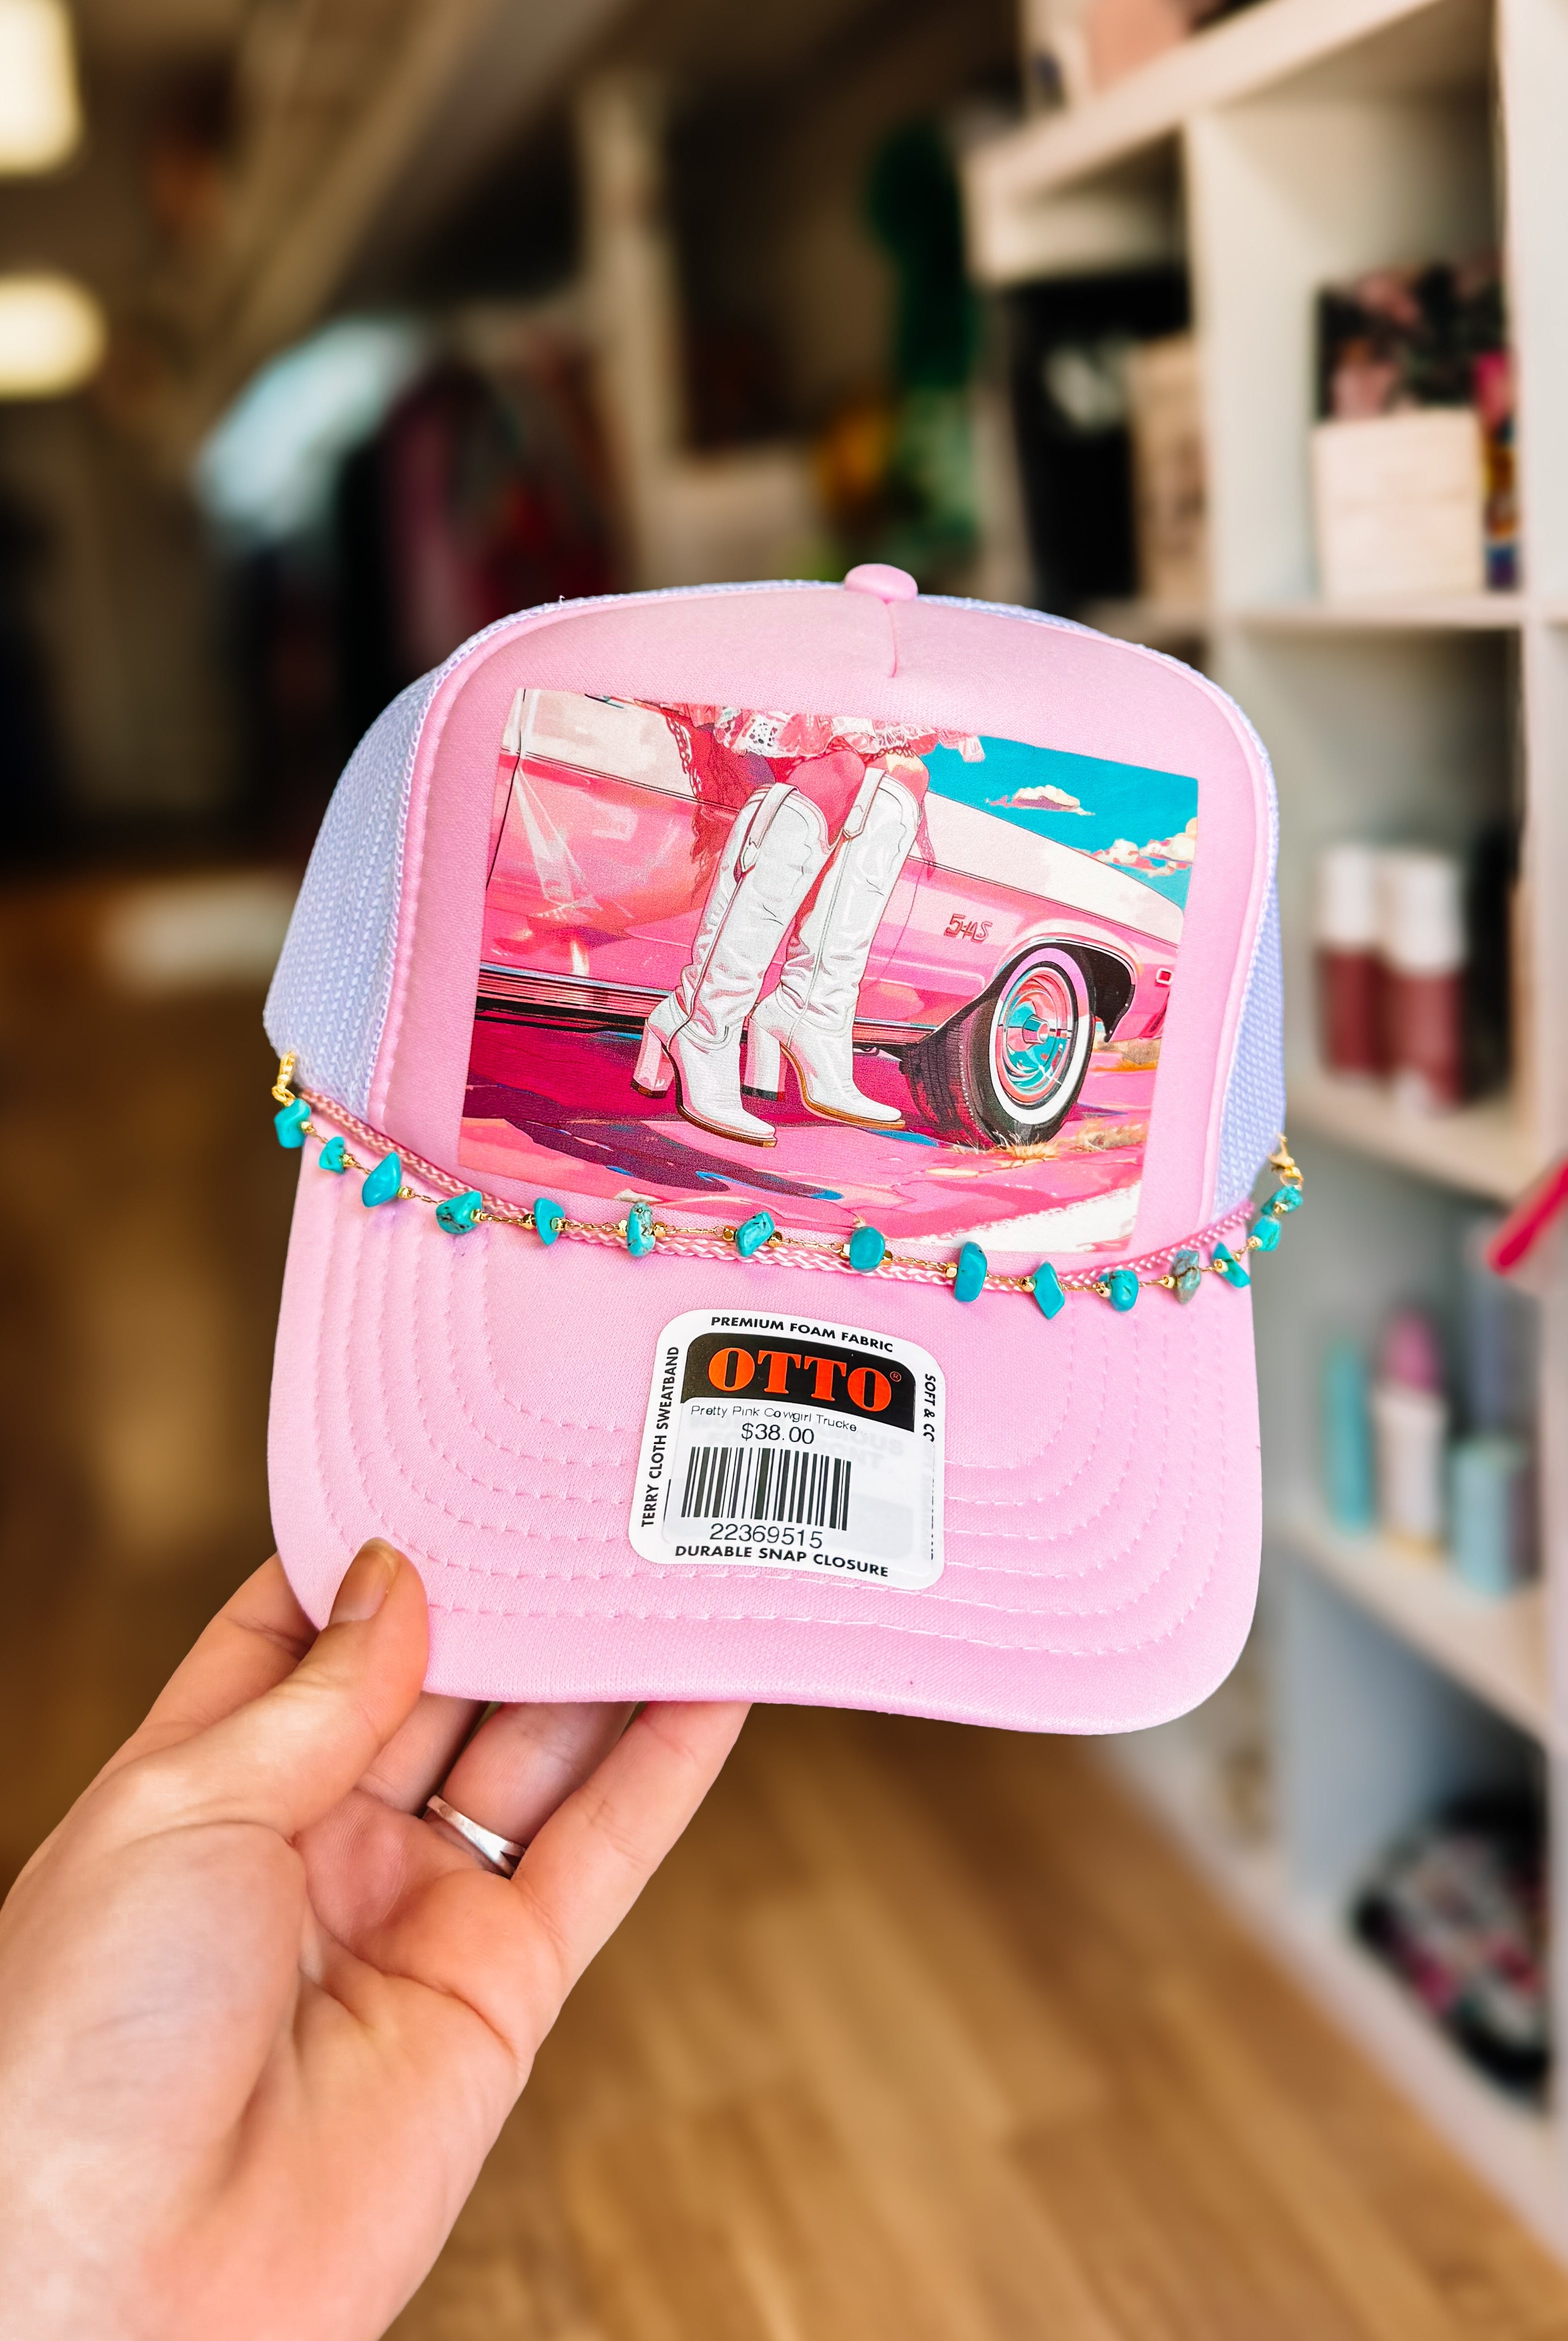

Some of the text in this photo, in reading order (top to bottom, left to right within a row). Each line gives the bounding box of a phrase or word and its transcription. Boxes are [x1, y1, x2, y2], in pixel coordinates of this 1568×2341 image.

[711, 1316, 893, 1353] PREMIUM FOAM FABRIC
[924, 1373, 936, 1407] SOFT
[691, 1405, 728, 1418] Pretty
[733, 1406, 759, 1417] Pink
[764, 1407, 812, 1423] Cowgirl
[924, 1408, 935, 1418] &
[641, 1347, 679, 1527] TERRY CLOTH SWEATBAND
[741, 1422, 815, 1445] $38.00
[709, 1523, 823, 1549] 22369515
[675, 1545, 889, 1577] DURABLE SNAP CLOSURE
